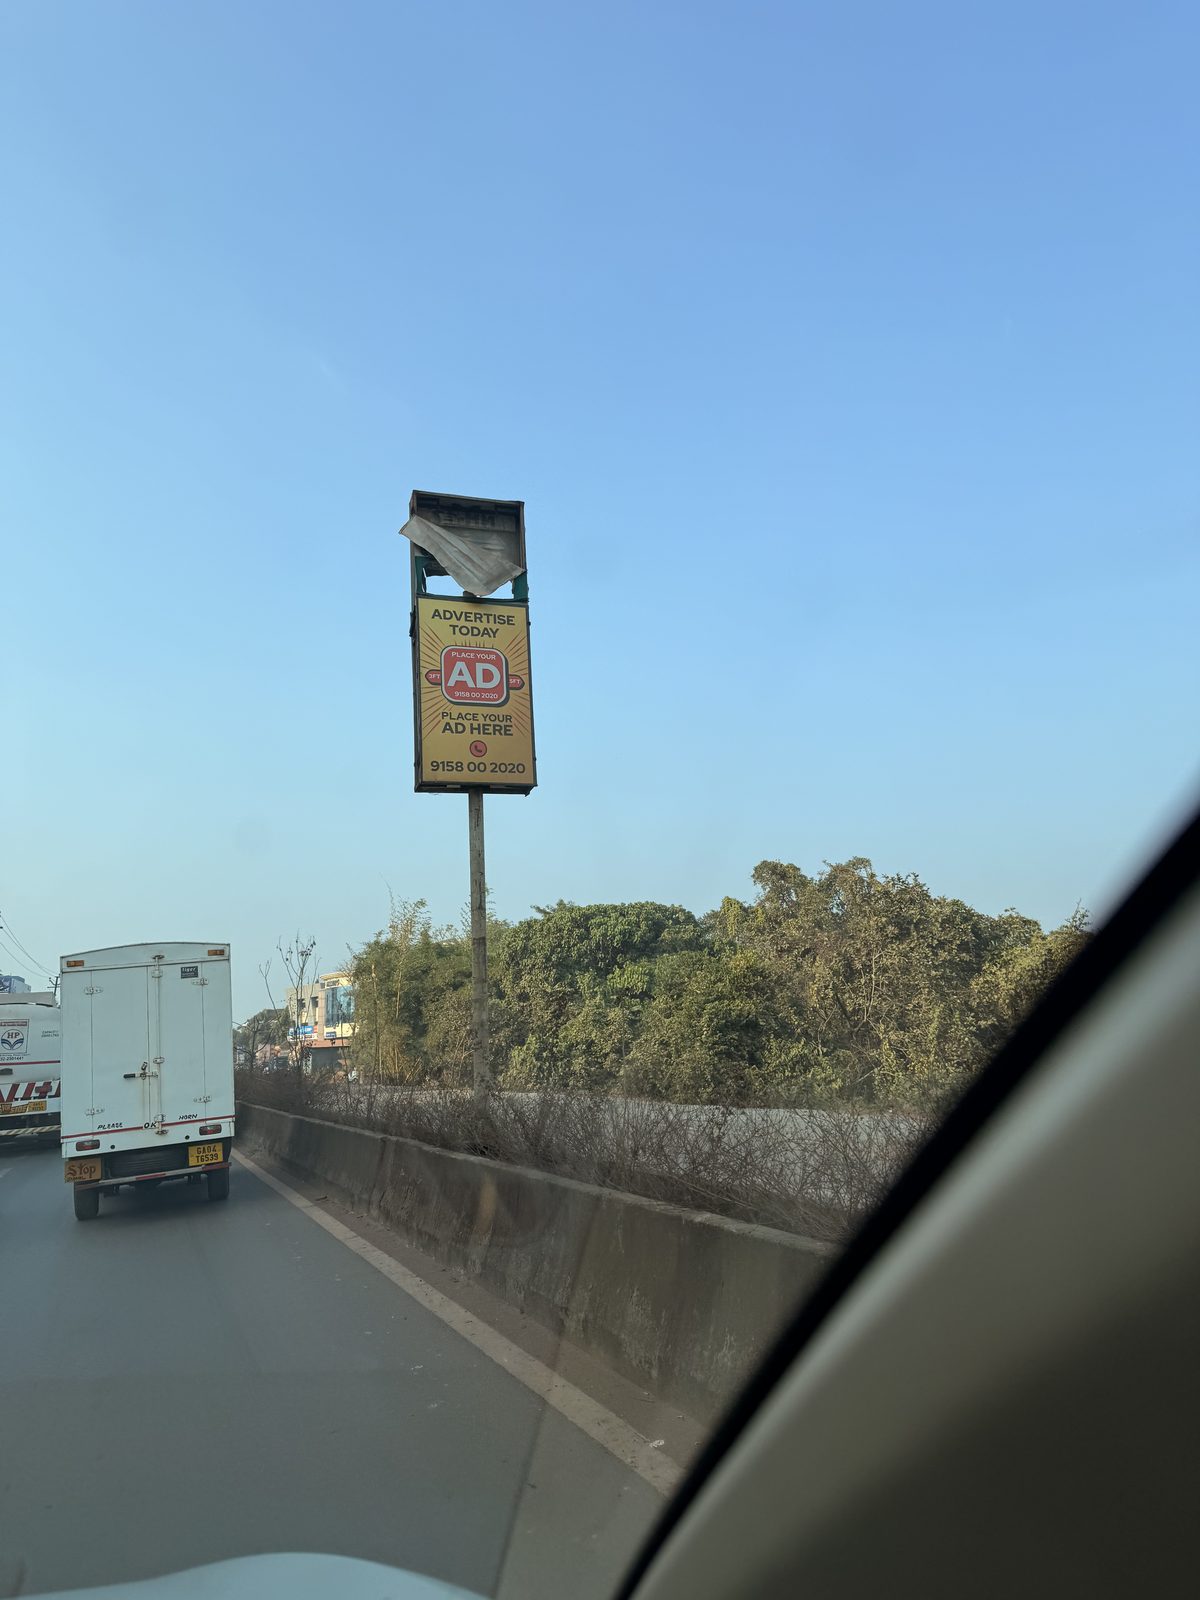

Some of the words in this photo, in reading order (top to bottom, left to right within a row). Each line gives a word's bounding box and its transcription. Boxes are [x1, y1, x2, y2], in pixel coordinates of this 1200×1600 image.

[431, 608, 515, 626] ADVERTISE
[449, 624, 500, 638] TODAY
[451, 651, 475, 659] PLACE
[476, 652, 496, 660] YOUR
[447, 661, 501, 689] AD
[441, 711, 479, 722] PLACE
[481, 713, 513, 723] YOUR
[442, 722, 467, 735] AD
[470, 723, 514, 736] HERE
[430, 760, 464, 773] 9158
[467, 762, 487, 773] 00
[490, 762, 526, 774] 2020
[7, 1031, 20, 1039] HP
[97, 1122, 123, 1130] PLEASE
[196, 1145, 217, 1154] GA04
[195, 1153, 219, 1163] T6539
